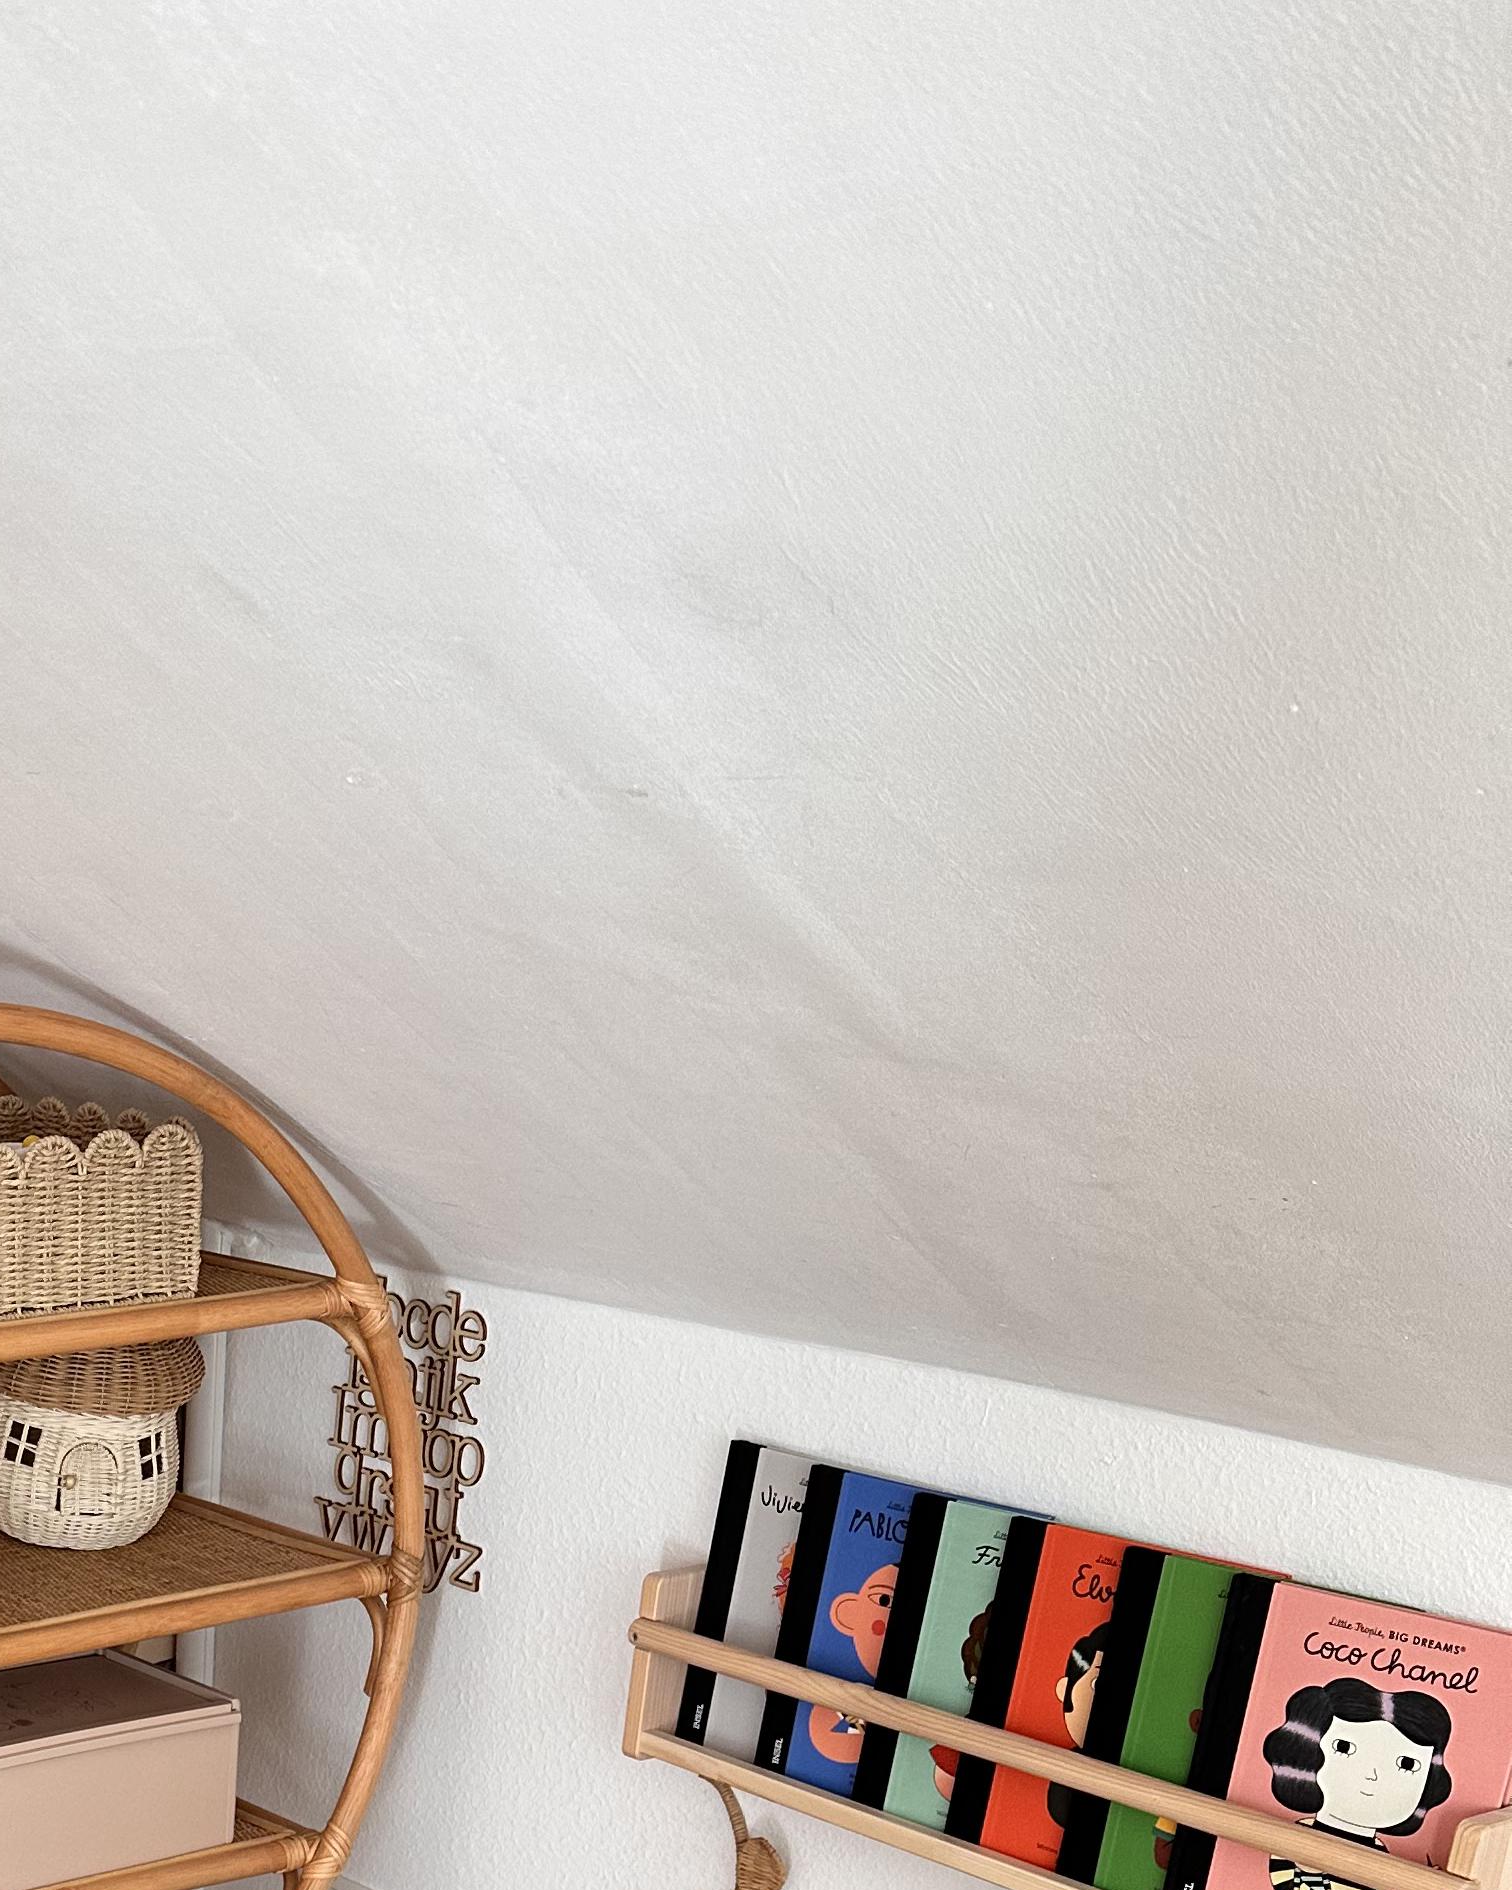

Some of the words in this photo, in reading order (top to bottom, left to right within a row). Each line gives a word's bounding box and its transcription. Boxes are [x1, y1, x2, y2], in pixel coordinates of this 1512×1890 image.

[1388, 1630, 1409, 1643] BIG
[1303, 1631, 1368, 1666] Coco
[1370, 1648, 1480, 1694] Chanel
